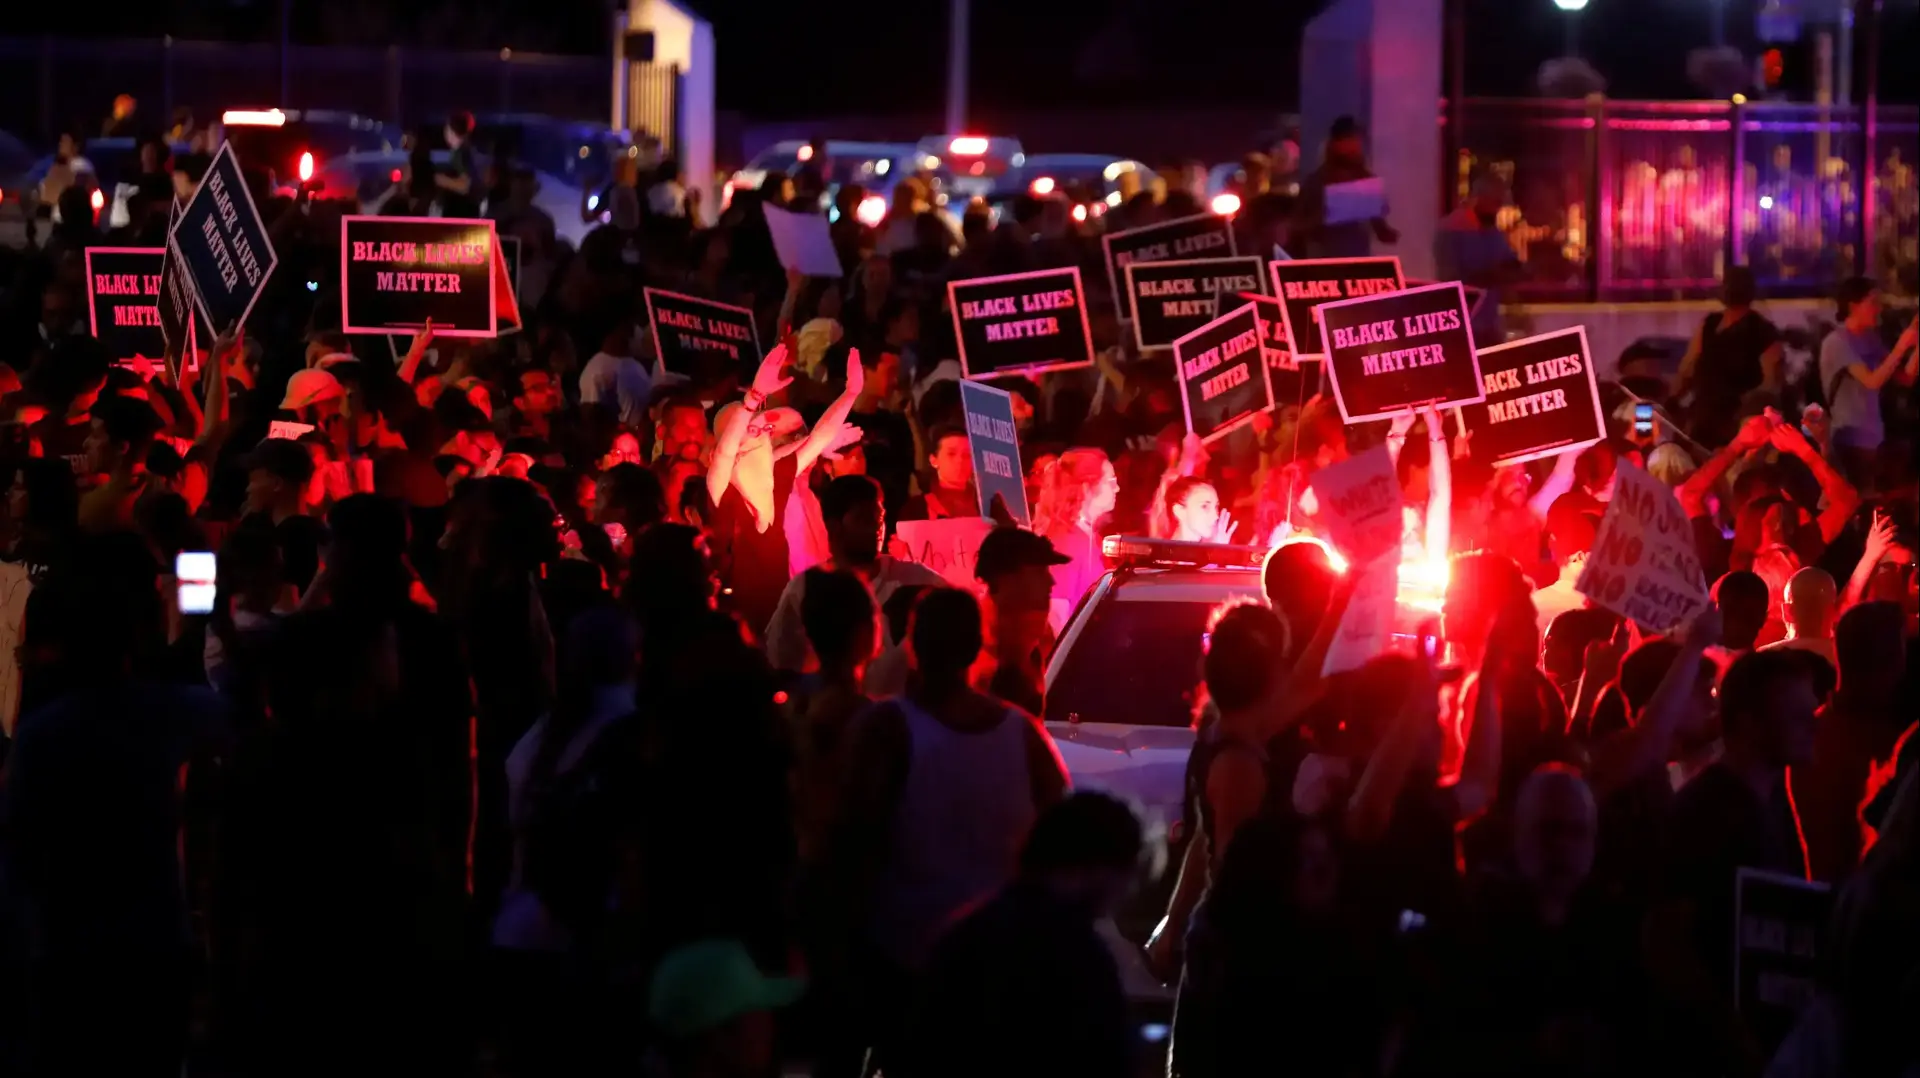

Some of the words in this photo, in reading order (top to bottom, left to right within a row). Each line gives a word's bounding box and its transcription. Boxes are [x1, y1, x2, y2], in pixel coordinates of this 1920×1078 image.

[208, 168, 238, 233] BLACK
[232, 226, 261, 288] LIVES
[202, 212, 239, 295] MATTER
[352, 241, 418, 262] BLACK
[424, 243, 485, 265] LIVES
[95, 274, 140, 295] BLACK
[376, 271, 462, 294] MATTER
[1138, 277, 1197, 297] BLACK
[1201, 274, 1257, 293] LIVES
[1284, 280, 1342, 300] BLACK
[1344, 277, 1398, 297] LIVES
[114, 305, 161, 327] MATTE
[961, 296, 1018, 321] BLACK
[1021, 288, 1075, 313] LIVES
[1162, 299, 1214, 317] MATT
[656, 307, 704, 332] BLACK
[708, 318, 753, 342] LIVES
[984, 316, 1060, 344] MATTER
[1332, 319, 1399, 350] BLACK
[1402, 308, 1462, 338] LIVES
[1184, 346, 1222, 381] BLACK
[1220, 328, 1257, 362] LIVES
[1360, 343, 1446, 377] MATTER
[1200, 362, 1251, 402] MATTER
[1483, 368, 1522, 395] ACK
[1524, 353, 1583, 386] LIVES
[1486, 388, 1568, 425] MATTER
[968, 411, 993, 438] BLACK
[992, 417, 1014, 445] LIVES
[981, 449, 1013, 479] MATTER
[1618, 476, 1655, 527] NO
[1597, 521, 1644, 567] NO
[1583, 564, 1626, 603] NO
